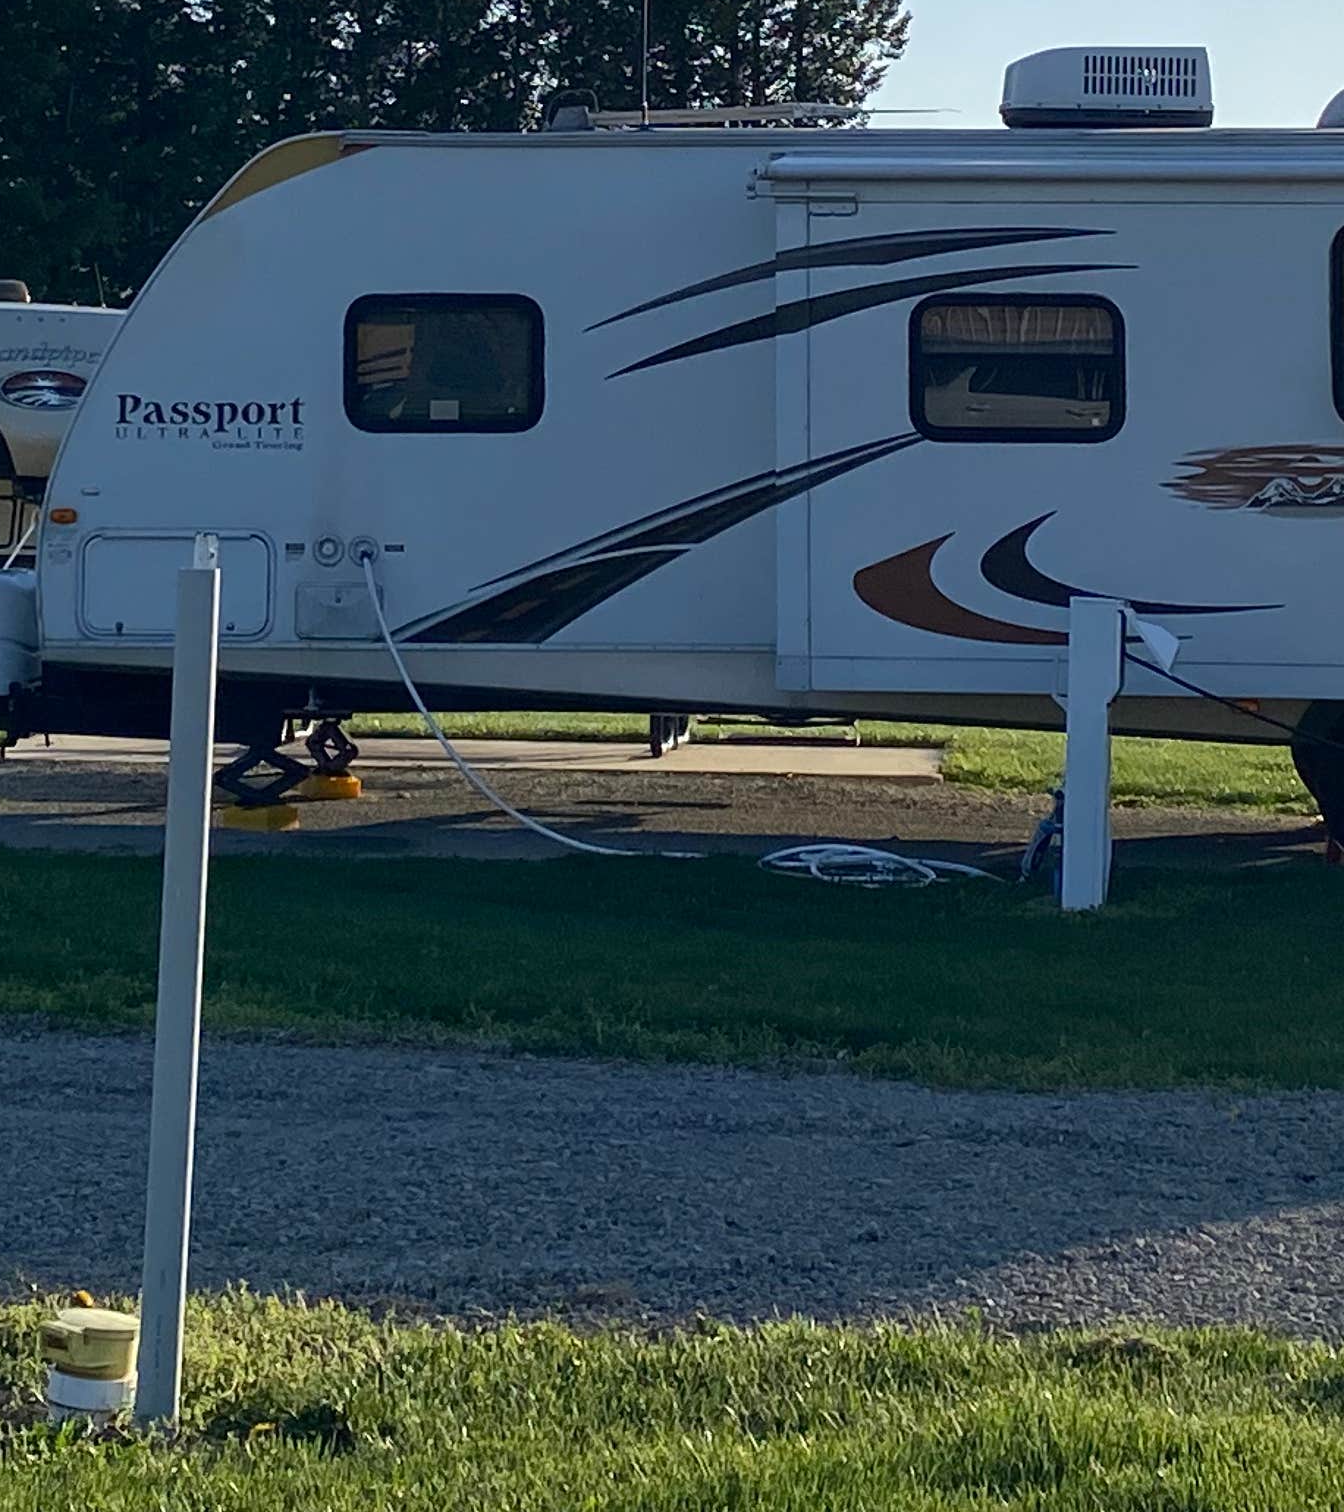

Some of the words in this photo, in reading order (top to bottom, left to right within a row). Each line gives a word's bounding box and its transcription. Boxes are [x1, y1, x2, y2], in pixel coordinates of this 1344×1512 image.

[115, 393, 306, 434] Passport
[115, 427, 210, 440] ULTRA
[237, 427, 305, 440] LITE
